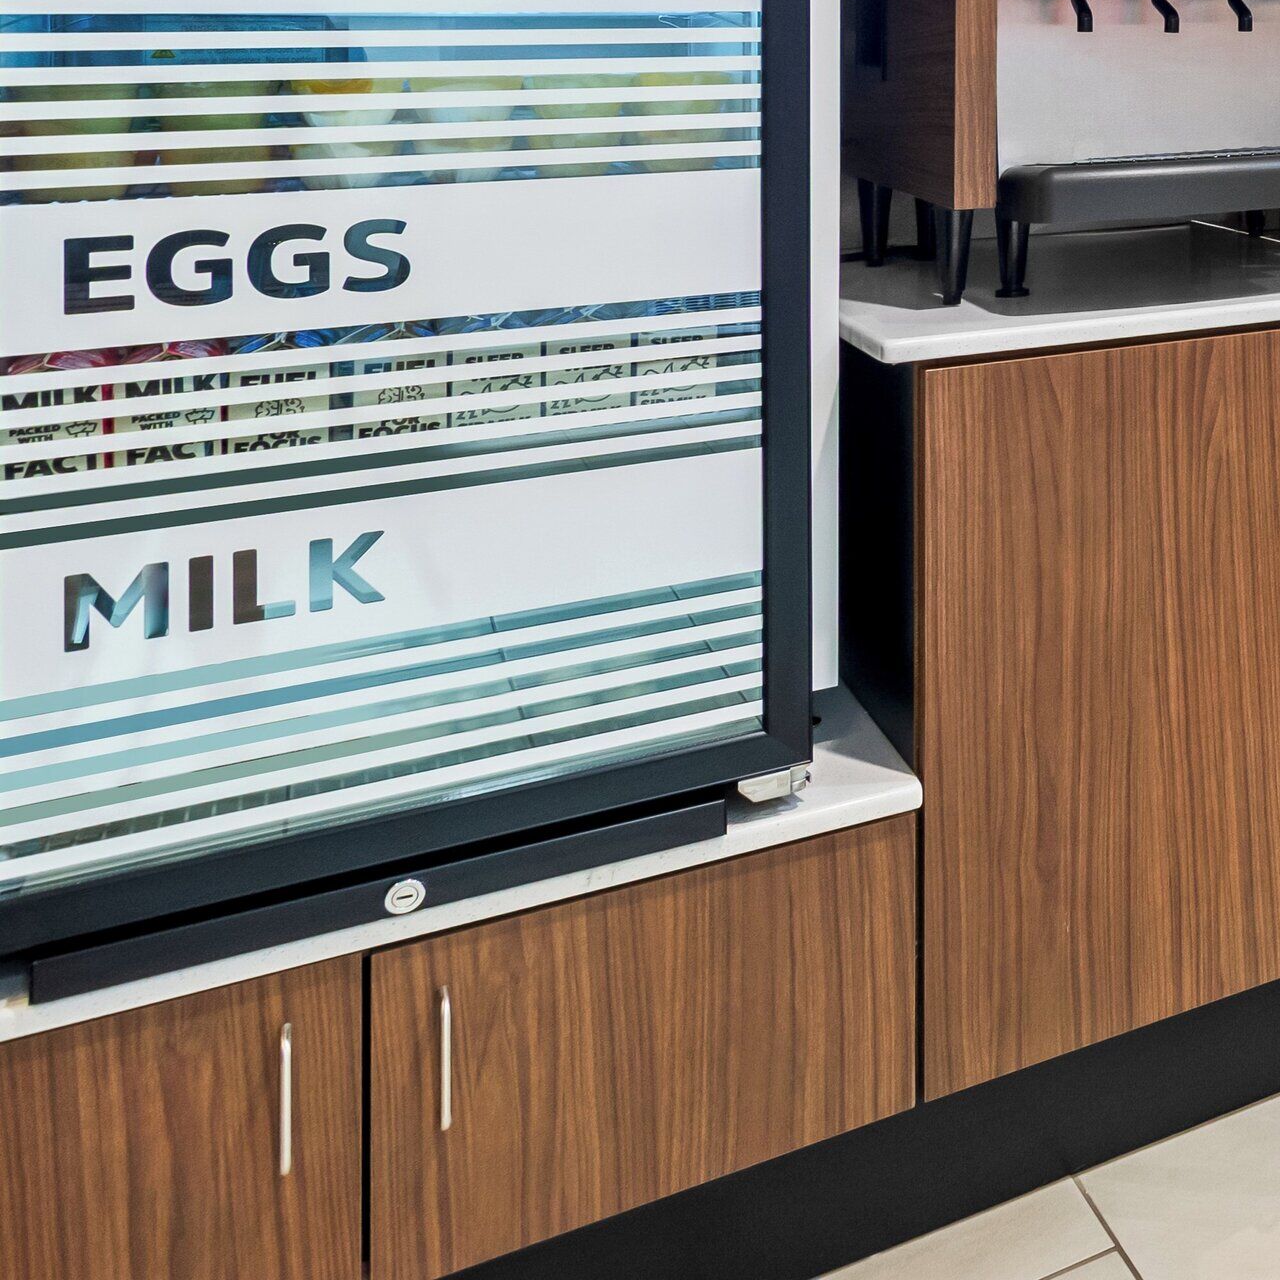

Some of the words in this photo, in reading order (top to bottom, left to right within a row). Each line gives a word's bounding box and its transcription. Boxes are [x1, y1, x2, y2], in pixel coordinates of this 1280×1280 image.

[64, 218, 411, 315] EGGS
[131, 411, 181, 423] PACKED
[9, 424, 61, 437] PACKED
[139, 420, 174, 431] WITH
[17, 433, 53, 443] WITH
[64, 530, 386, 653] MILK
